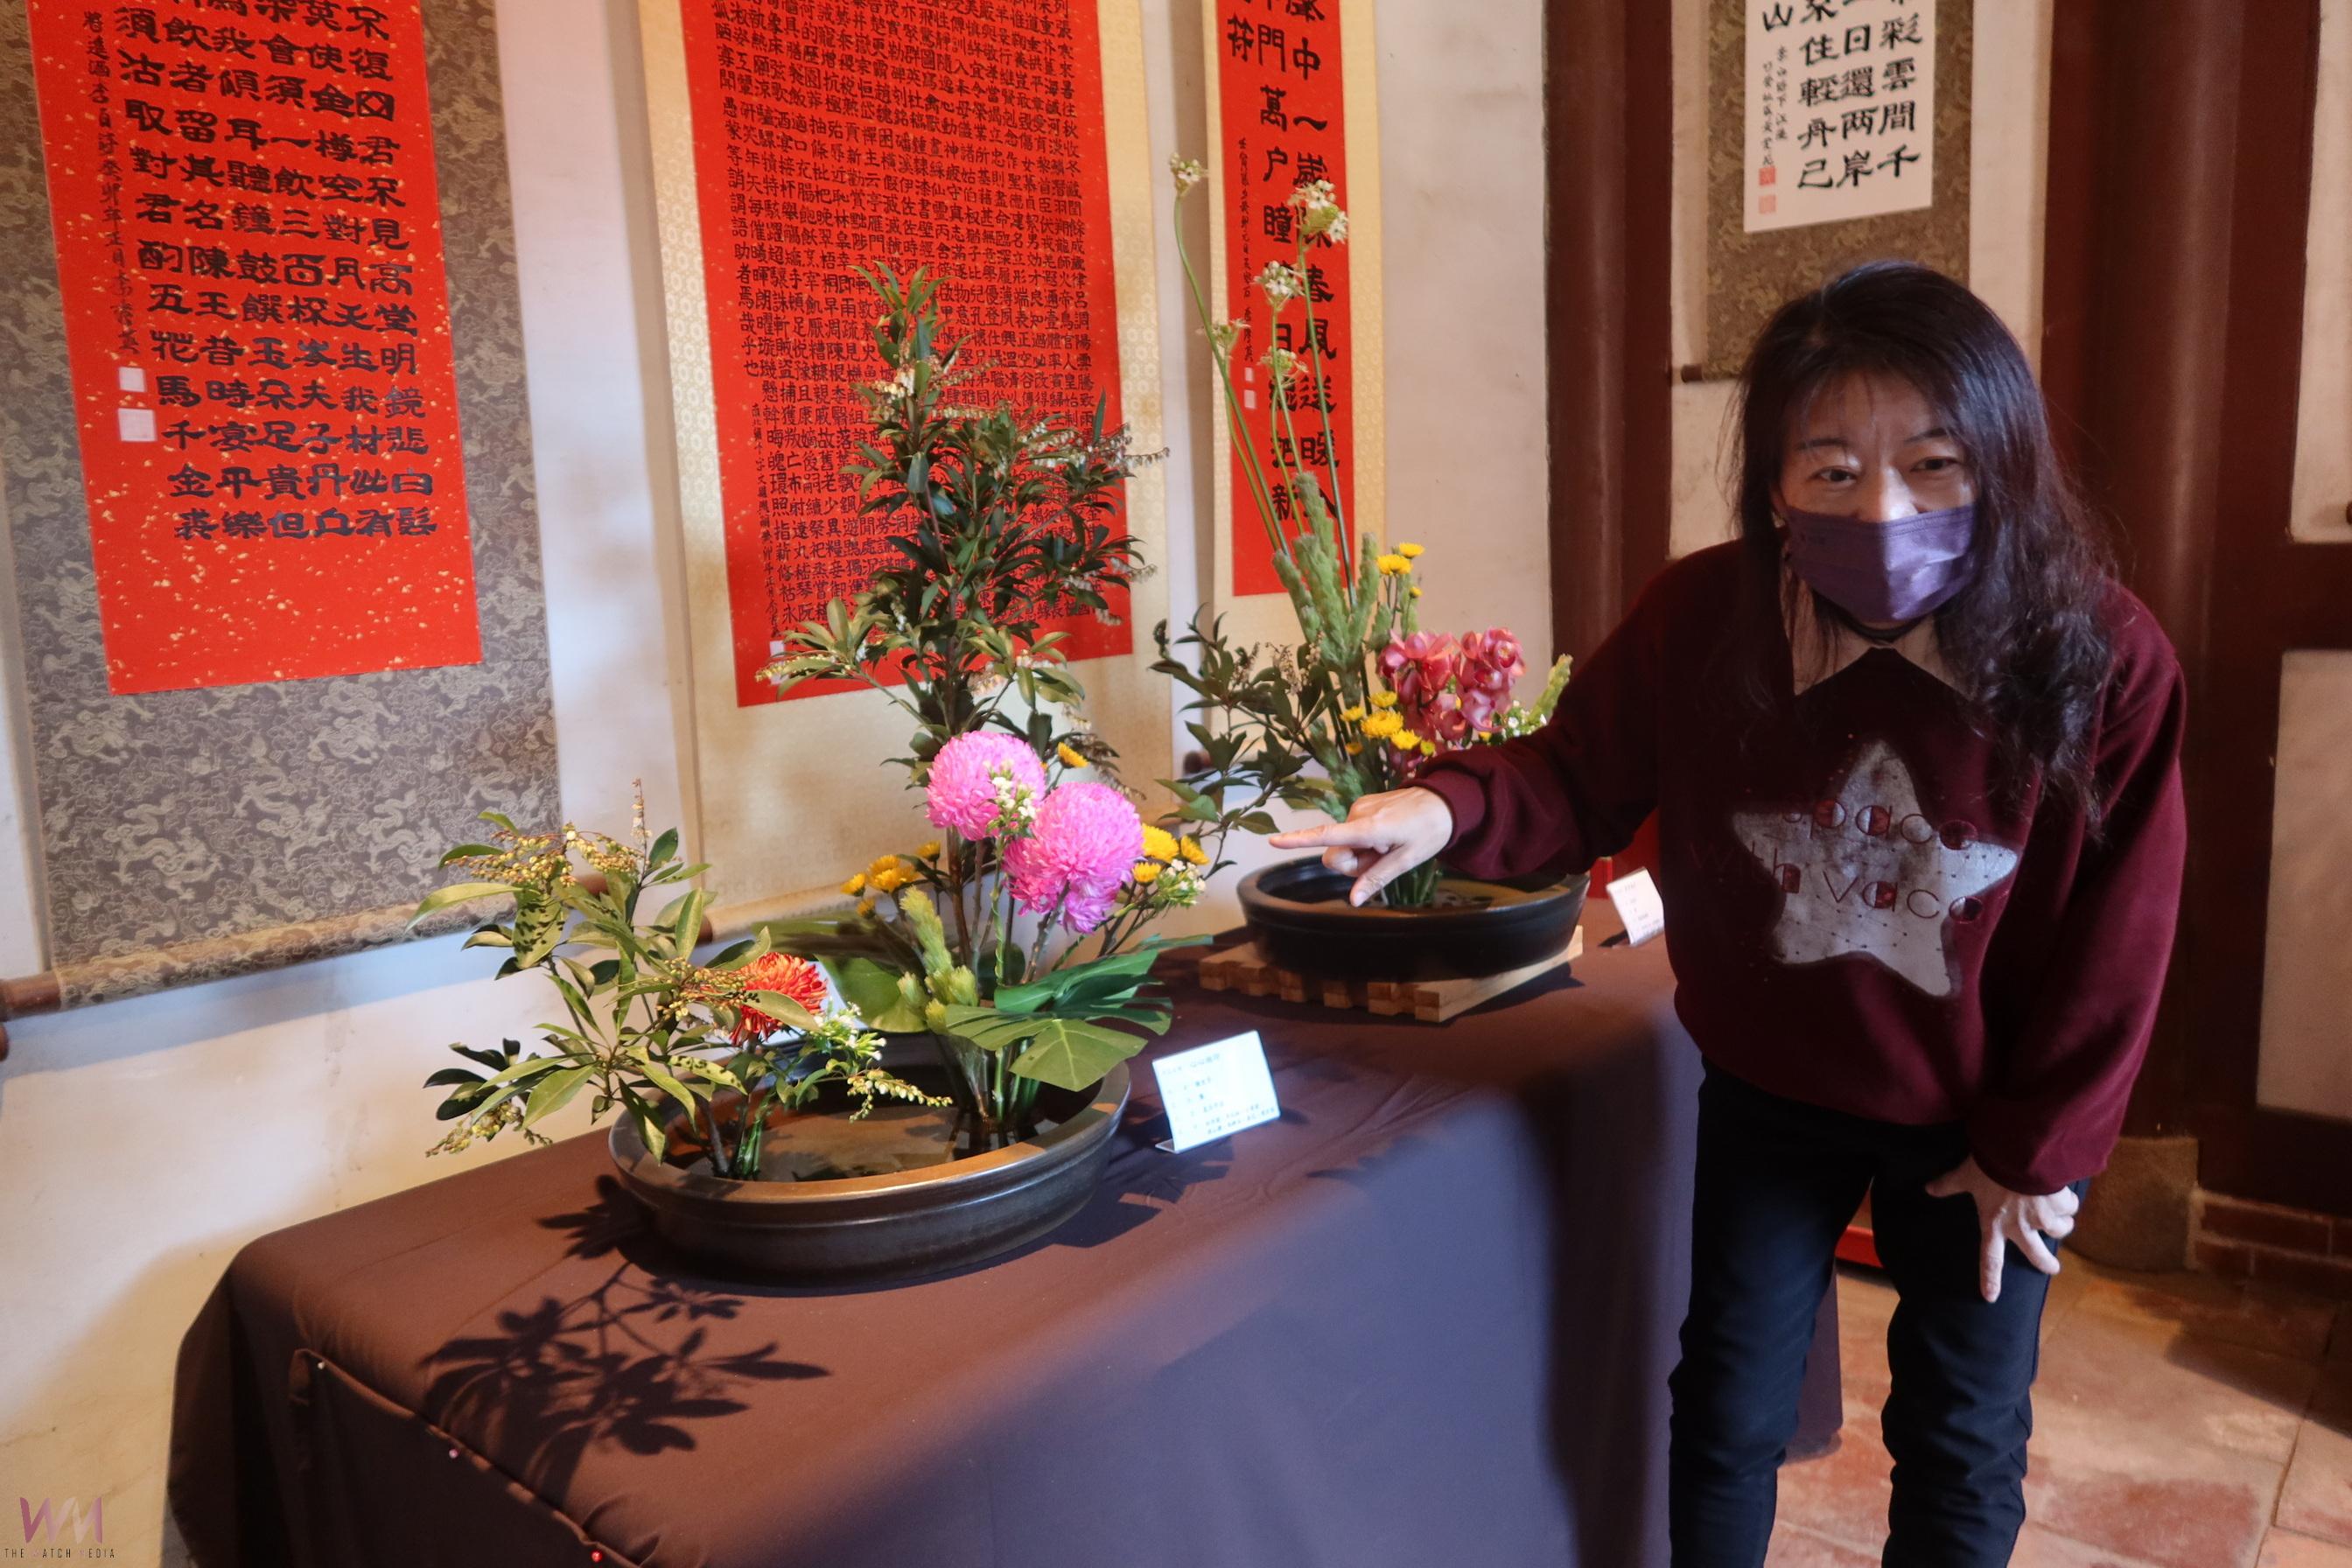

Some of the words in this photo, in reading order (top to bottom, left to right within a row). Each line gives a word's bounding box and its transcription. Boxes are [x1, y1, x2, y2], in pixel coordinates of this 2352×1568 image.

[1762, 2, 1794, 32] 山
[1878, 0, 1923, 178] 彩雲間千
